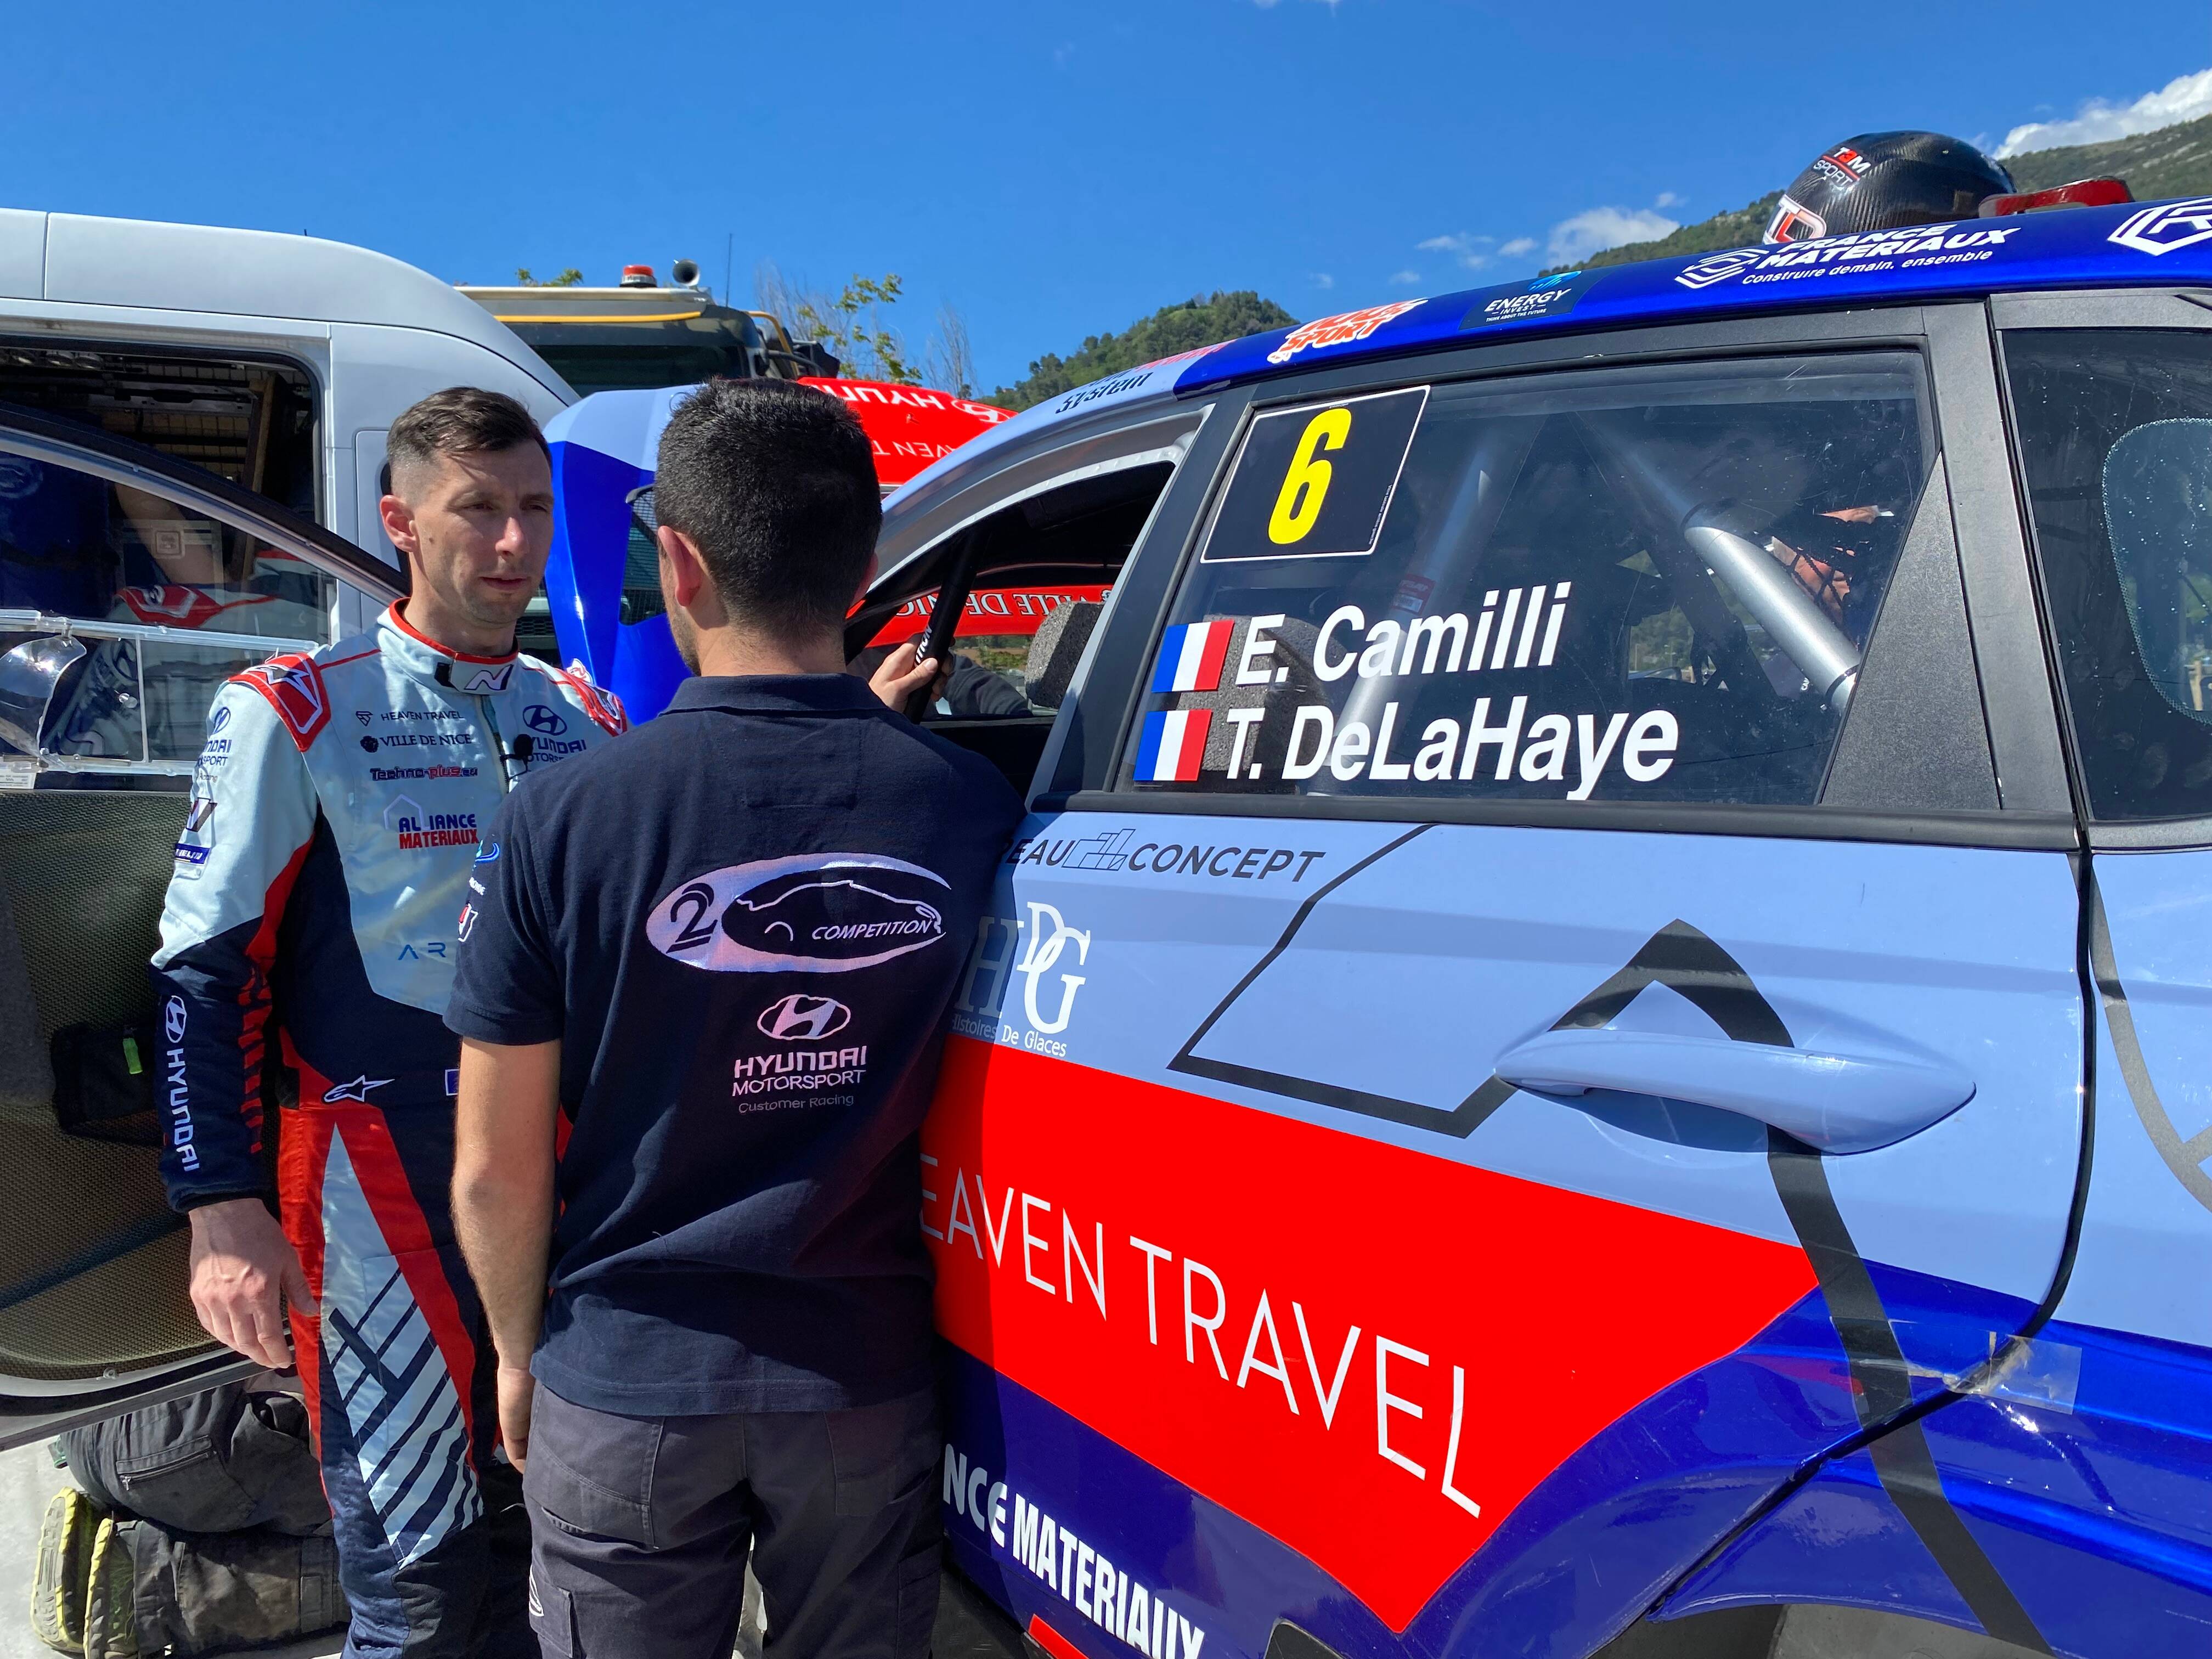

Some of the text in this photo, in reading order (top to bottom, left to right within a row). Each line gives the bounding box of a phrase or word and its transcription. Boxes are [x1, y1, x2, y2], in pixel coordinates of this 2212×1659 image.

[1813, 160, 1853, 186] SPORT
[1755, 228, 2022, 270] MATERIAUX
[1776, 224, 1958, 254] FRANCE
[1742, 267, 1824, 285] Construire
[1901, 249, 1994, 268] ensemble
[1484, 288, 1572, 312] ENERGY
[1500, 304, 1537, 315] INVEST
[1527, 308, 1547, 316] FUTURE
[1279, 317, 1387, 352] SPORT
[1268, 408, 1352, 544] 6
[1234, 581, 1572, 686] E. Camilli
[381, 710, 465, 721] HEAVEN TRAVEL
[380, 733, 472, 747] VILLE DE NICE
[1226, 695, 1679, 802] T. DeLaHaye
[398, 814, 477, 833] ALLIANCE
[399, 828, 479, 850] MATERIAUX
[1128, 843, 1326, 883] CONCEPT
[811, 920, 933, 940] COMPETITION
[1001, 1024, 1019, 1045] De
[1024, 1030, 1067, 1057] Glaces
[734, 1045, 867, 1079] HYUNDAI
[732, 1069, 866, 1097] MOTORSPORT
[166, 1048, 200, 1172] HYUNDAI
[738, 1093, 854, 1114] Customer Racing
[1129, 1235, 1481, 1519] TRAVEL
